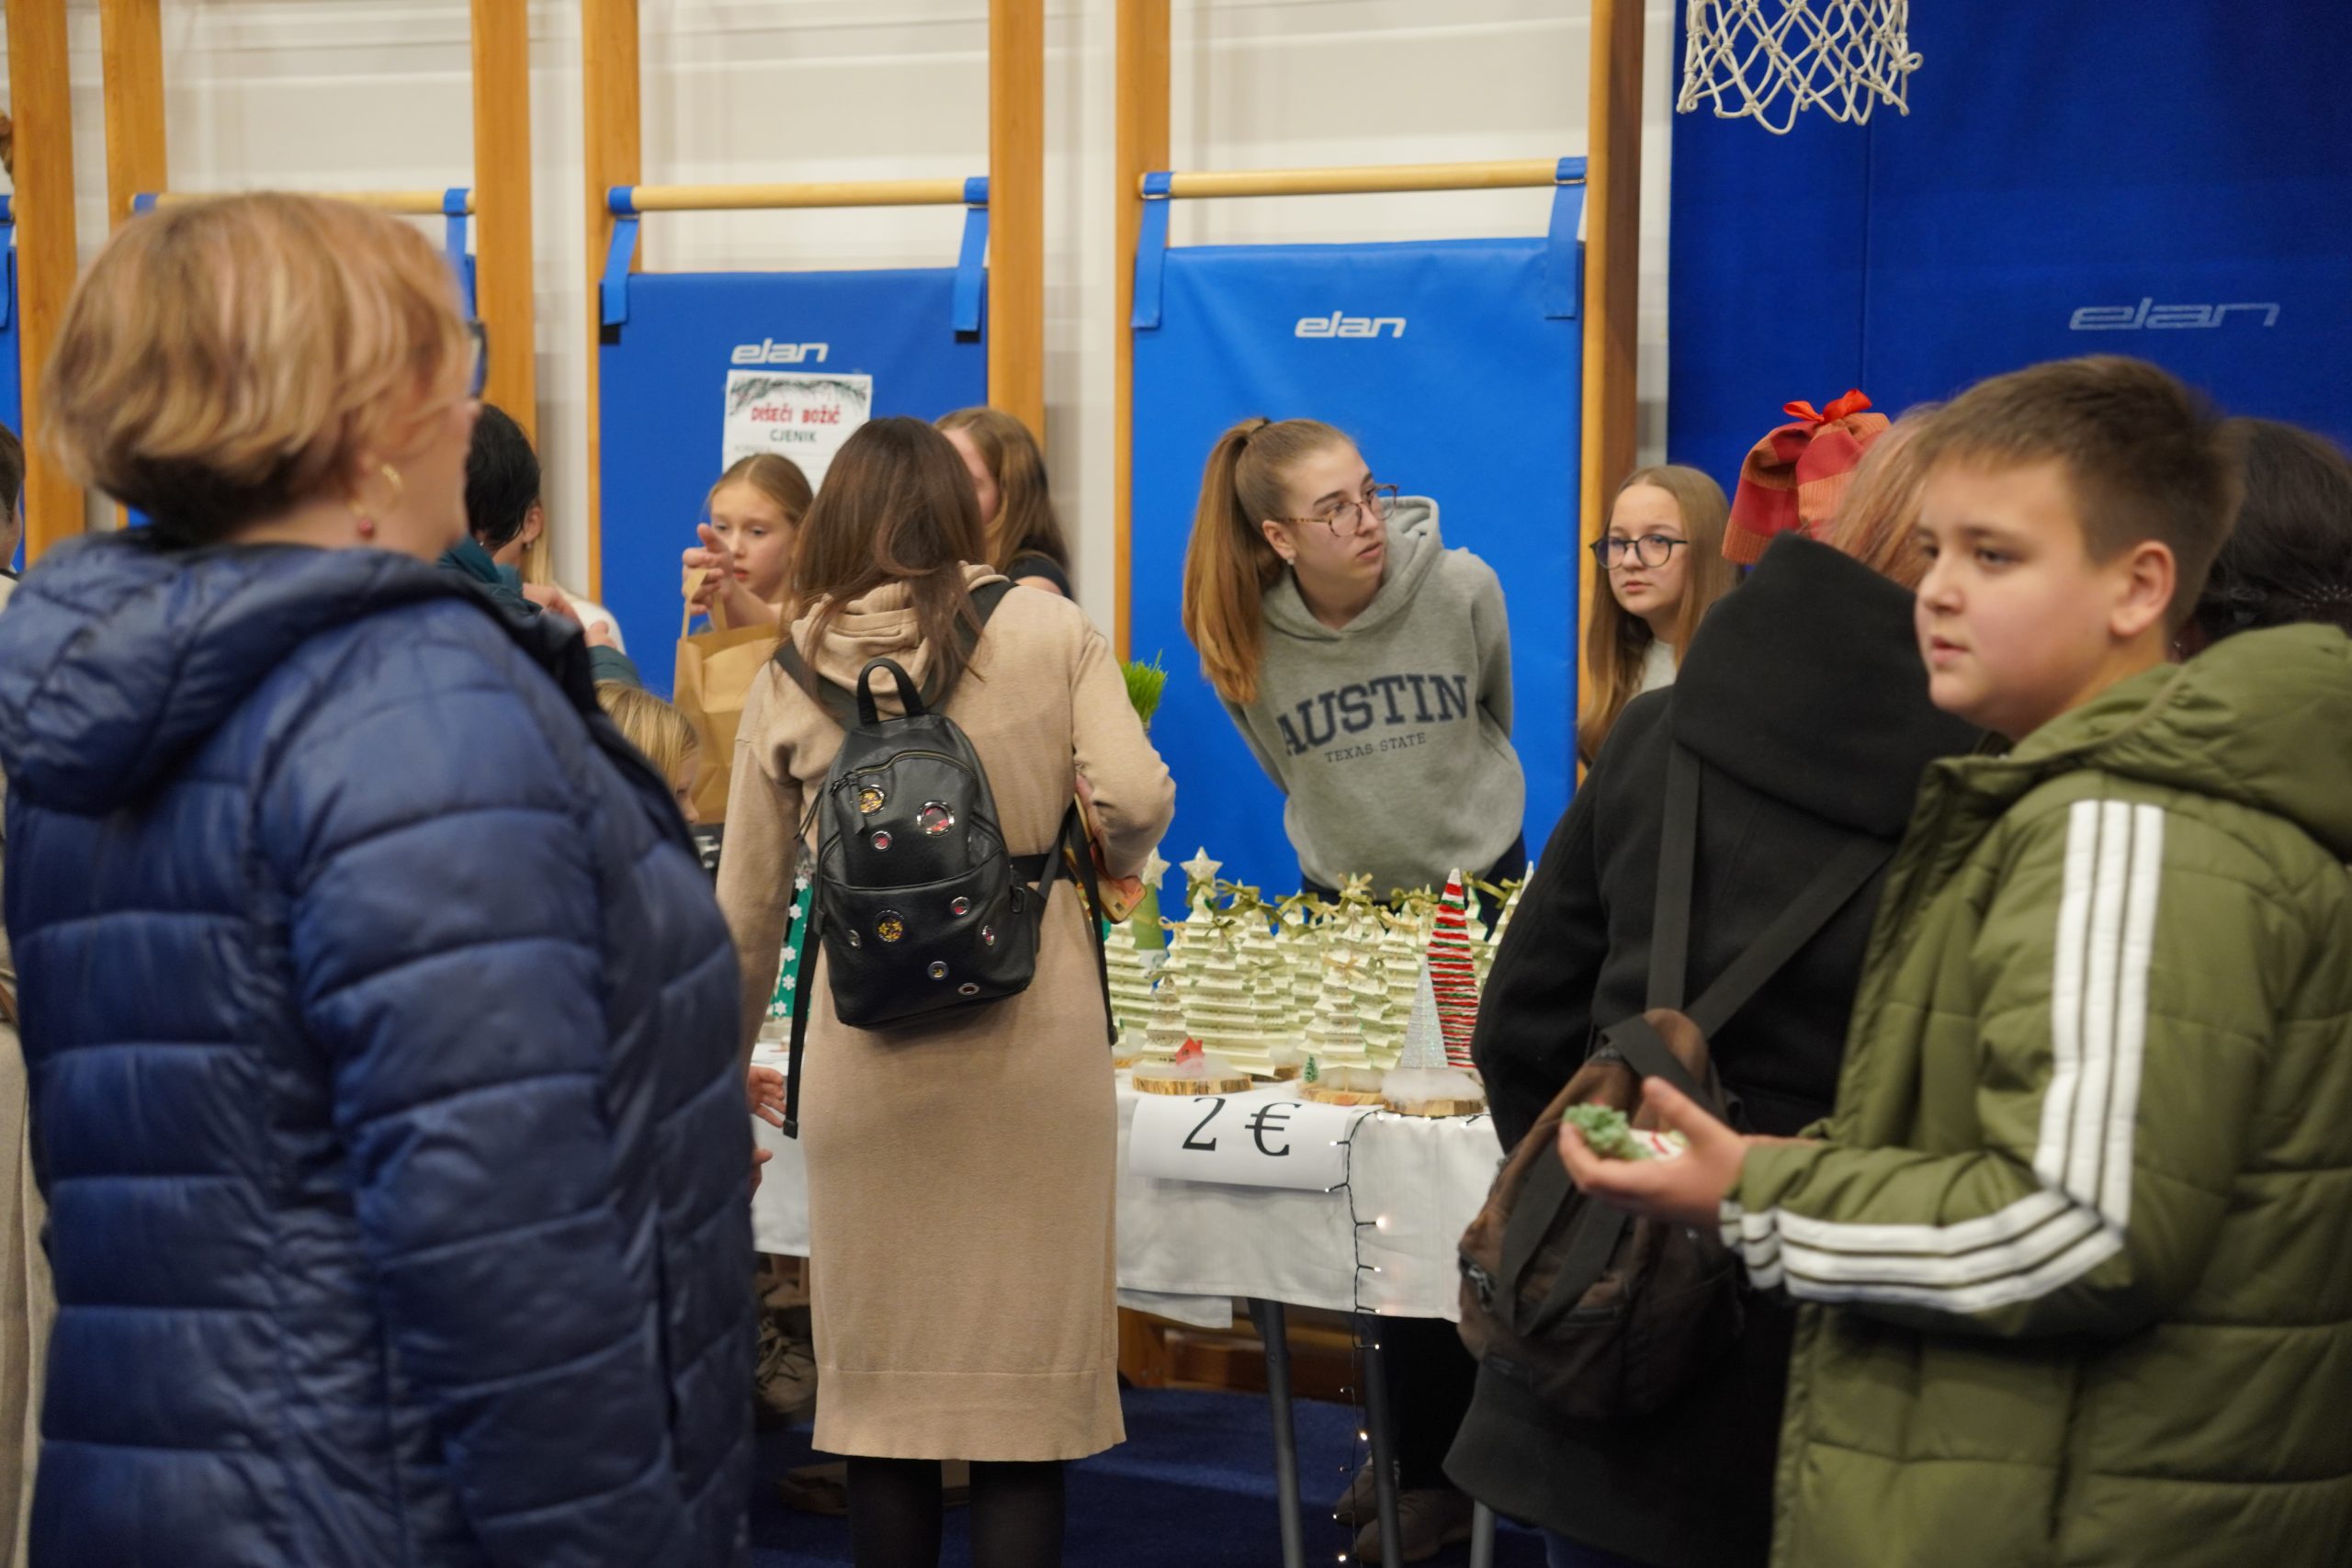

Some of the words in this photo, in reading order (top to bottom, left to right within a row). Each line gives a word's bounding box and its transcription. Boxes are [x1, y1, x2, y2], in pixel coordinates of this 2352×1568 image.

[1295, 310, 1407, 338] elan
[2069, 297, 2280, 331] elan
[730, 337, 830, 365] elan
[770, 429, 817, 443] CJENIK
[1277, 673, 1468, 756] AUSTIN
[1324, 743, 1374, 763] TEXAS
[1380, 732, 1427, 752] STATE
[1182, 1097, 1227, 1152] 2
[1244, 1101, 1303, 1157] €
